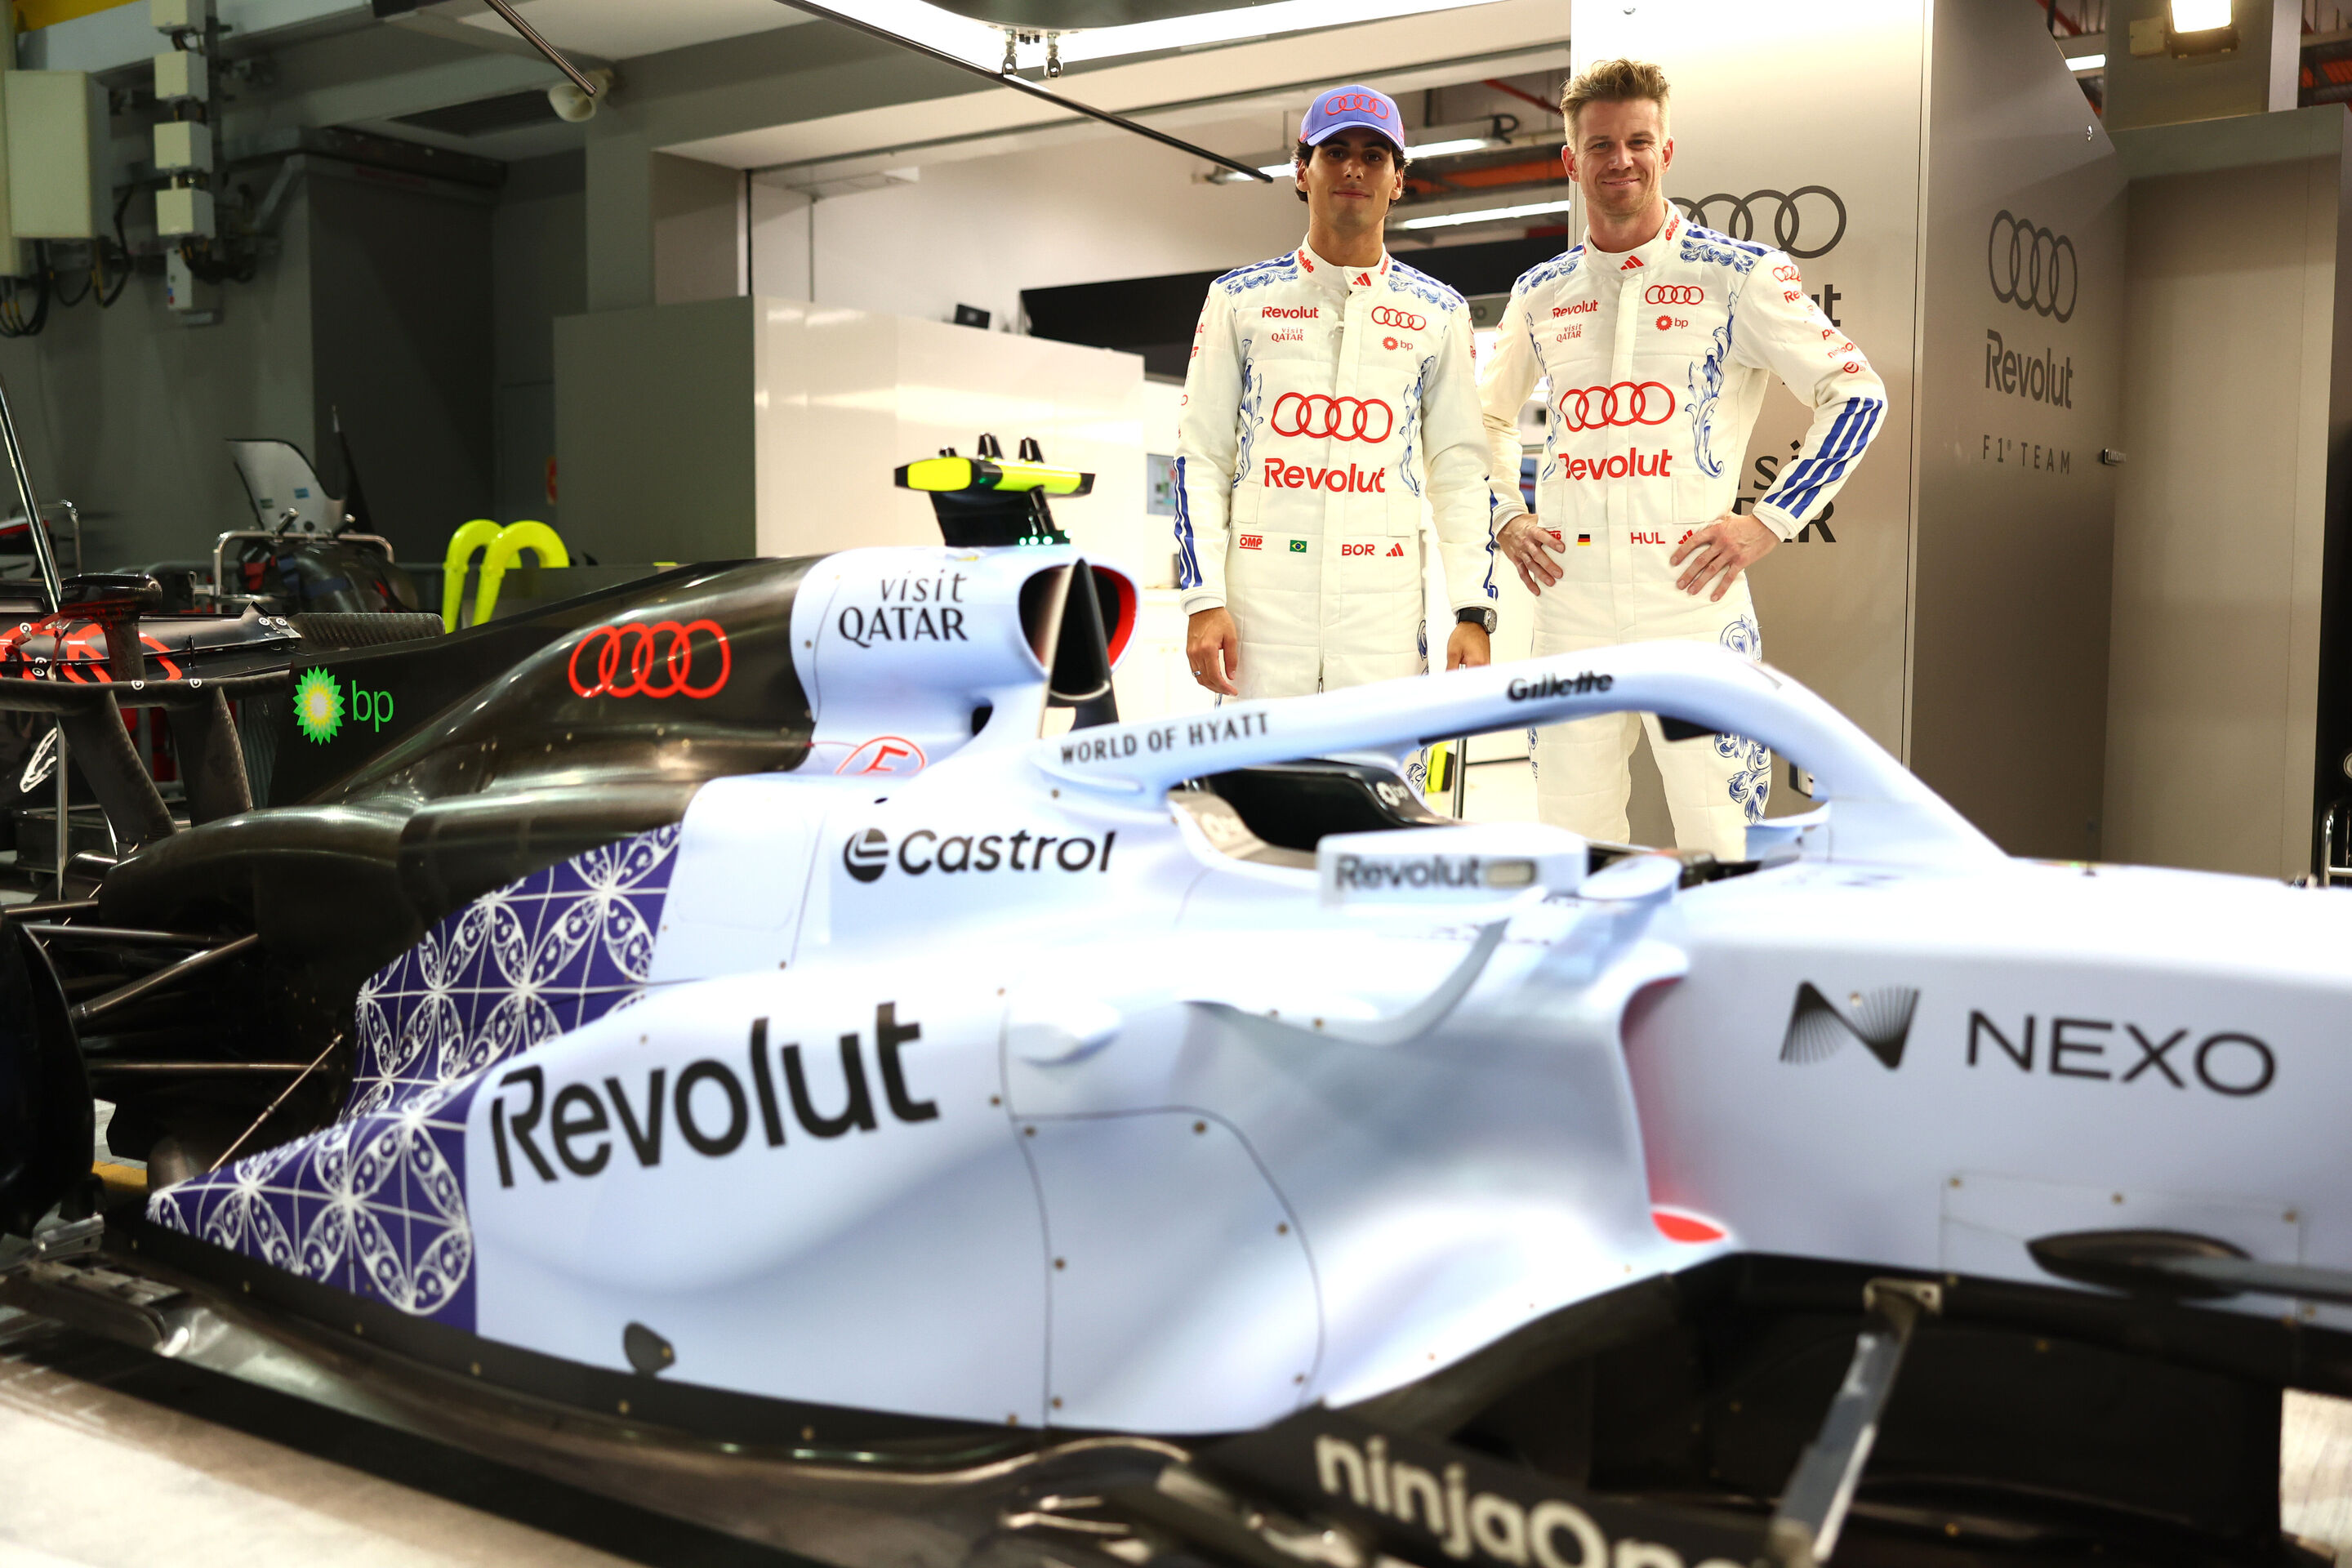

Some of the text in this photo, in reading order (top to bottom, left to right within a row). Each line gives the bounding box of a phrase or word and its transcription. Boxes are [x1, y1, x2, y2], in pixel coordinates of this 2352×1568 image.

[1262, 306, 1319, 318] Revolut
[1552, 300, 1598, 318] Revolut
[1675, 318, 1689, 329] bp
[1272, 332, 1303, 342] QATAR
[1556, 331, 1582, 343] QATAR
[1564, 323, 1583, 332] visit
[1400, 340, 1414, 351] bp
[1985, 328, 2073, 409] Revolut
[1265, 457, 1386, 493] Revolut
[2021, 442, 2070, 475] TEAM
[1239, 536, 1263, 549] OMP
[1341, 544, 1375, 556] BOR
[1630, 532, 1665, 545] HUL
[880, 569, 969, 604] visit
[838, 606, 969, 648] QATAR
[1507, 669, 1614, 702] Gillette
[351, 679, 394, 733] bp
[1061, 711, 1267, 765] WORLD OF HYATT
[898, 829, 1117, 876] Castrol
[1335, 853, 1481, 889] Revolut
[1967, 1009, 2277, 1098] NEXO
[491, 1000, 940, 1188] Revolut
